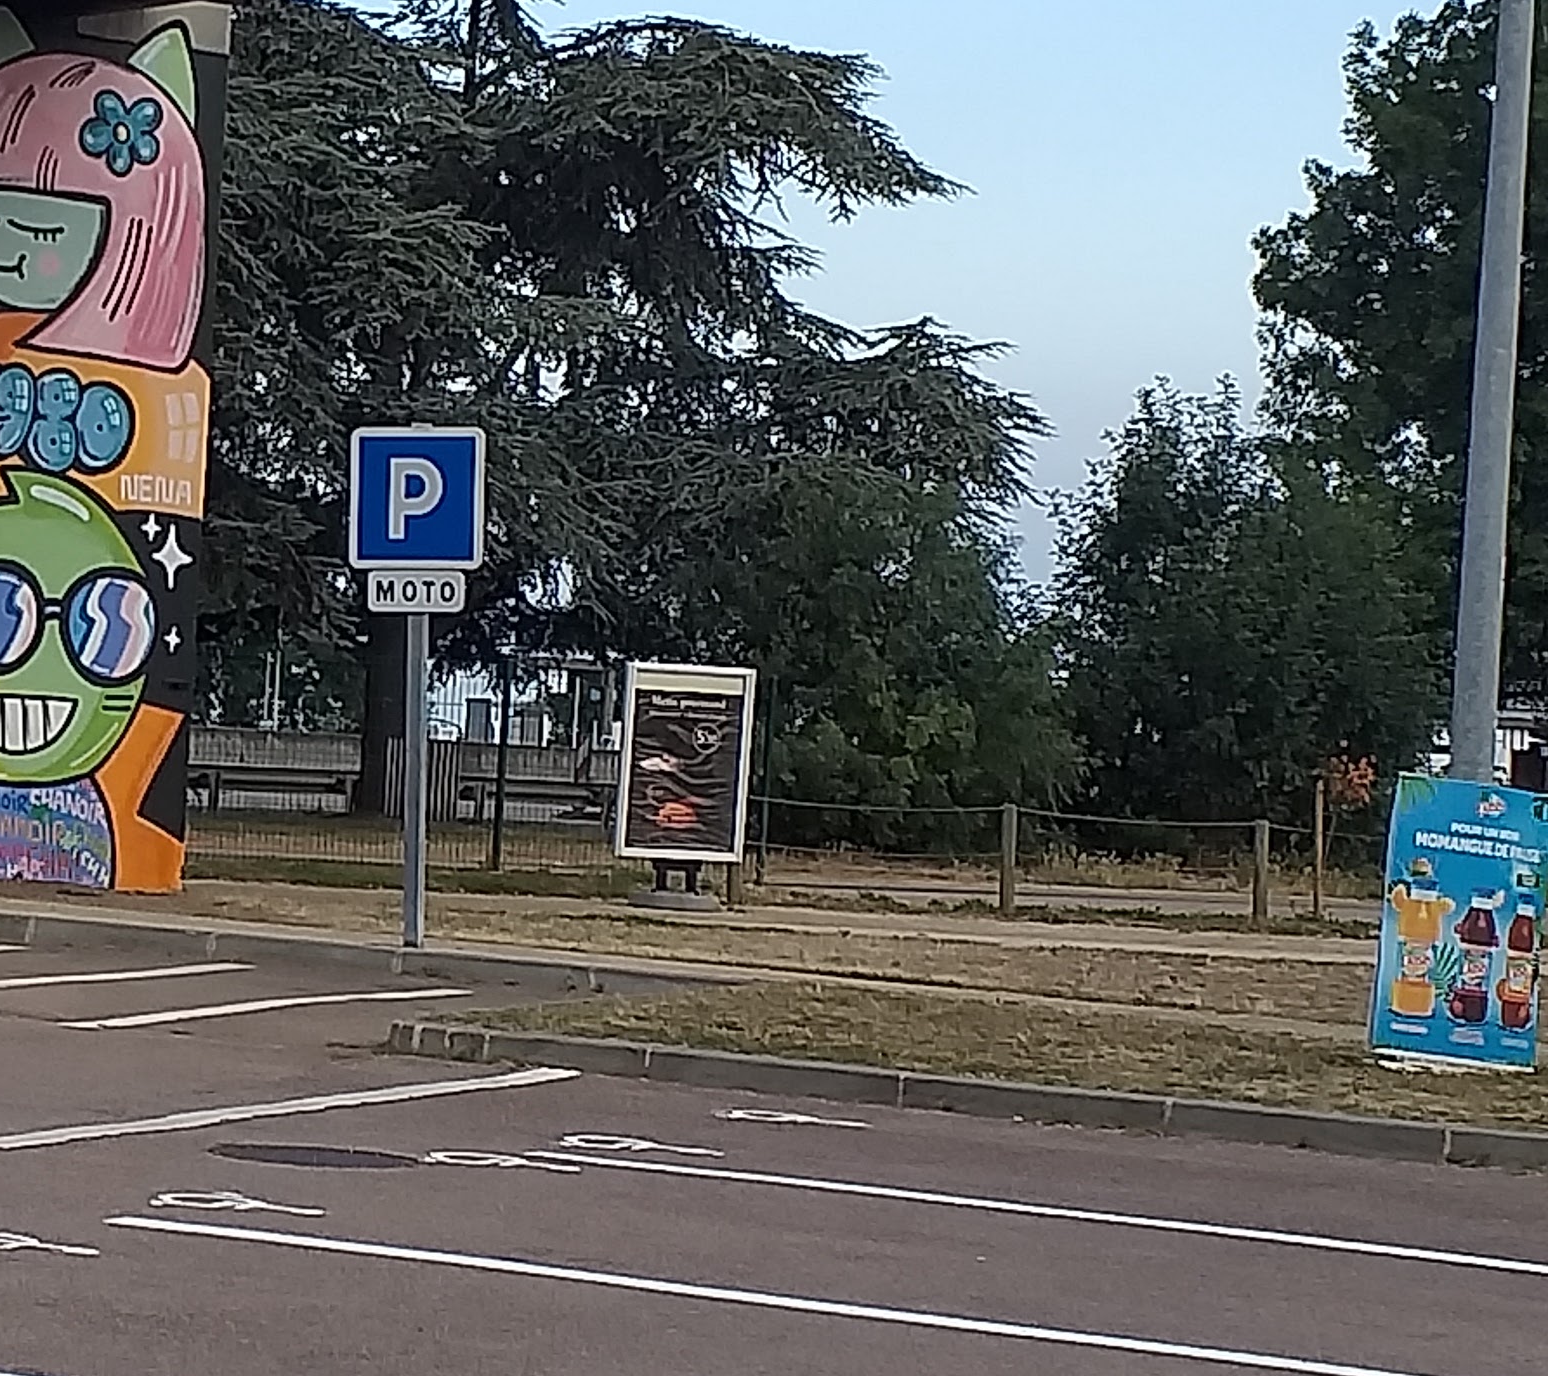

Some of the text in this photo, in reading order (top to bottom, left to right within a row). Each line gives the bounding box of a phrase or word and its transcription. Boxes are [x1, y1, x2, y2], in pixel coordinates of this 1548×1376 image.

[119, 473, 193, 506] NENA
[388, 457, 443, 540] P
[375, 579, 456, 604] MOTO
